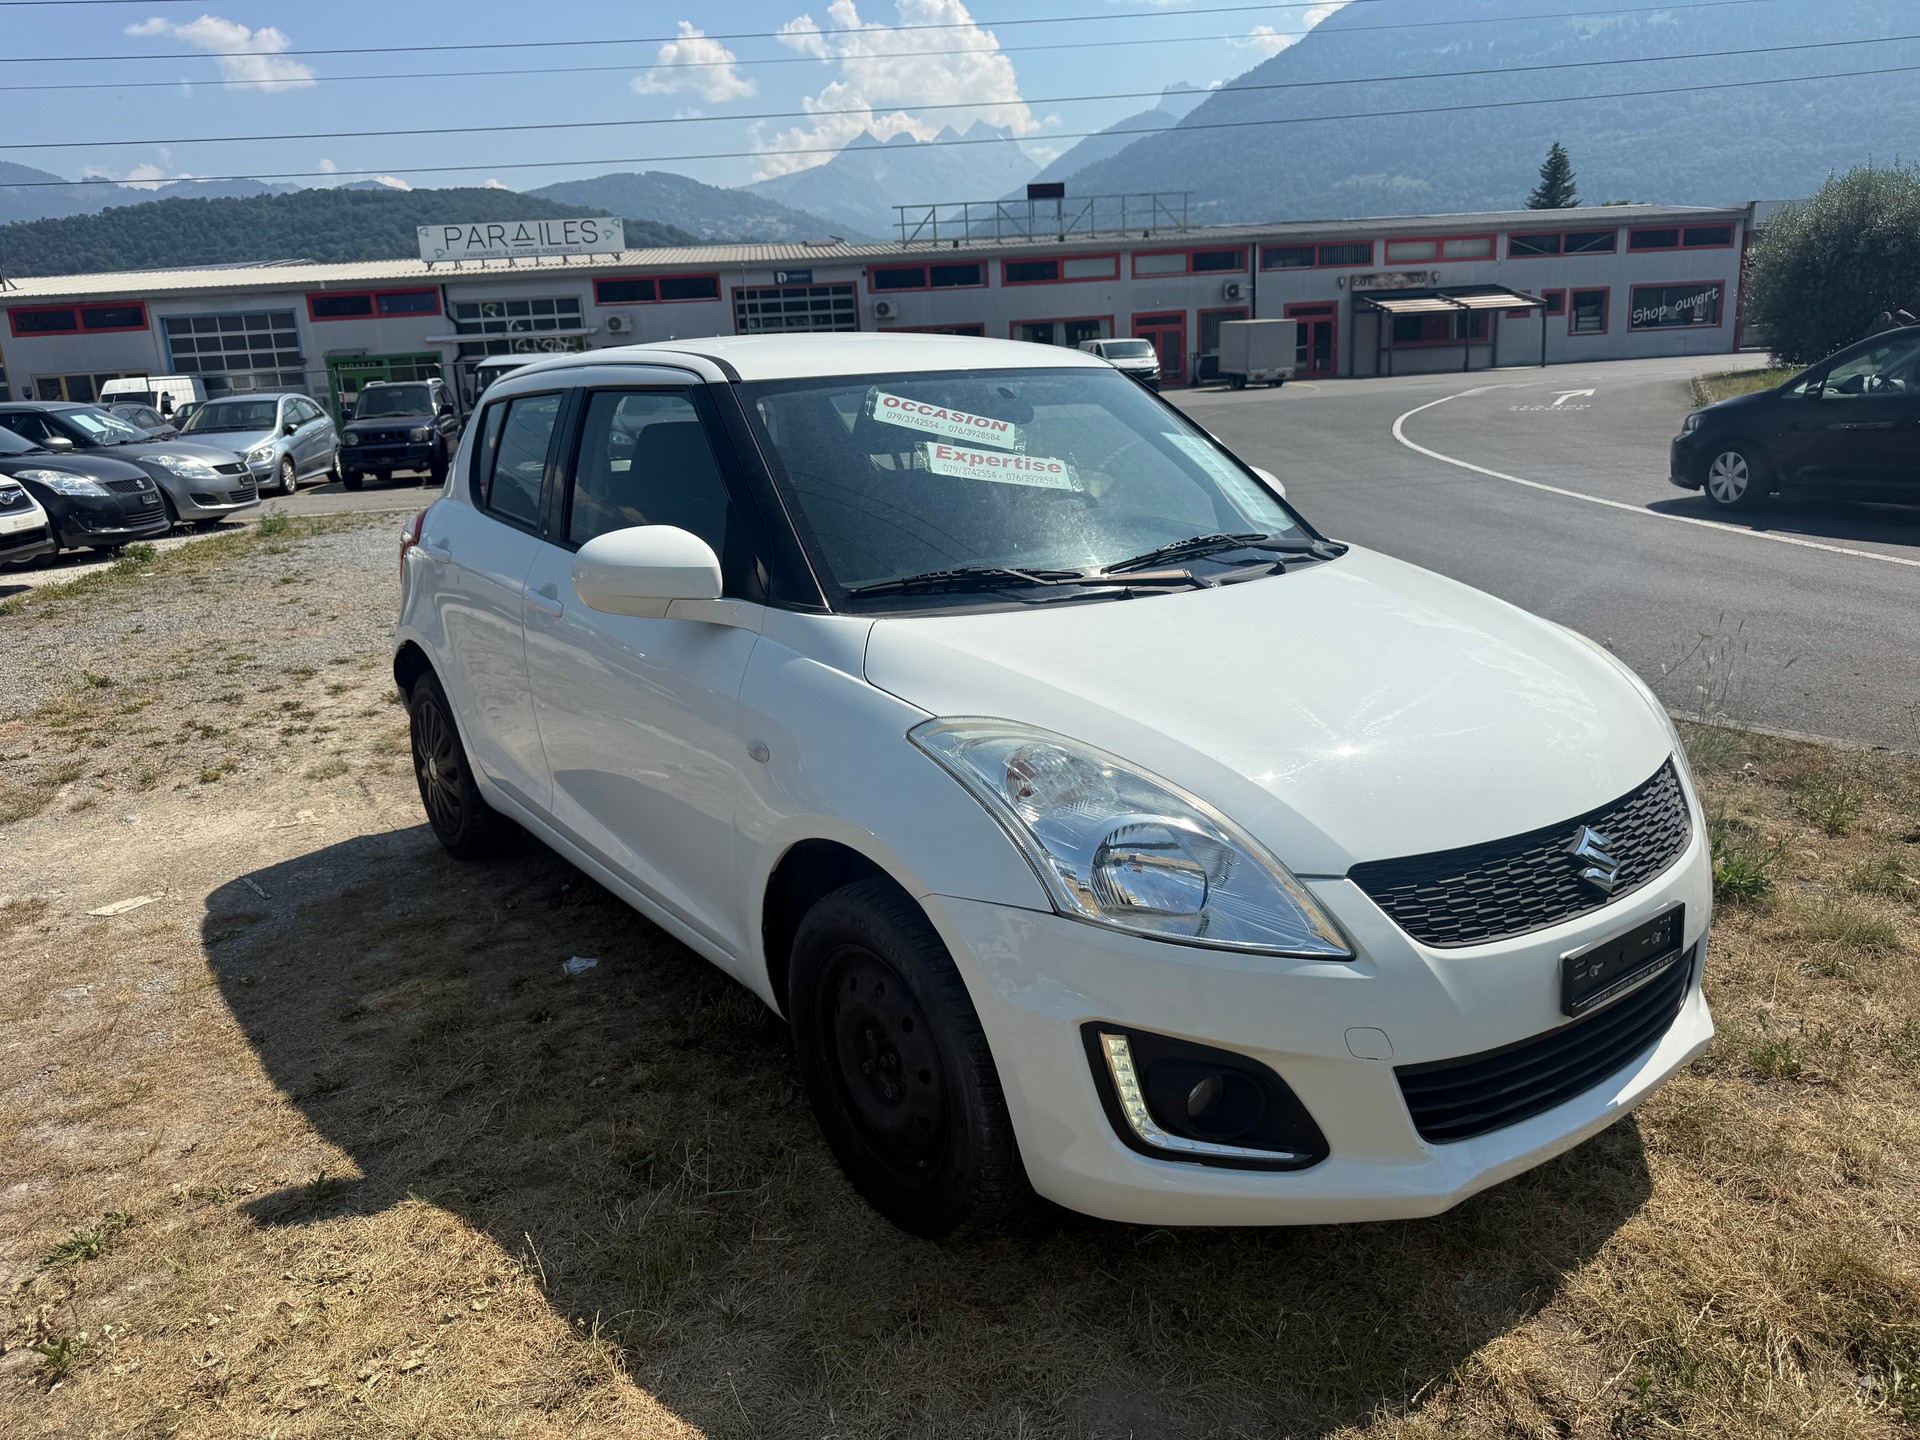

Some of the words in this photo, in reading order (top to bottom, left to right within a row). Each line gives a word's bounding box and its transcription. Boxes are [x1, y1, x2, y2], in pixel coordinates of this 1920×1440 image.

[1632, 304, 1667, 324] Shop
[1675, 287, 1719, 312] ouvert
[883, 397, 1009, 433] OCCASION
[886, 411, 939, 430] 079/3742554
[948, 424, 1001, 442] 076/3928584
[935, 445, 1063, 474] Expertise
[943, 463, 997, 479] 079/3742554
[850, 914, 905, 966] POLARIS
